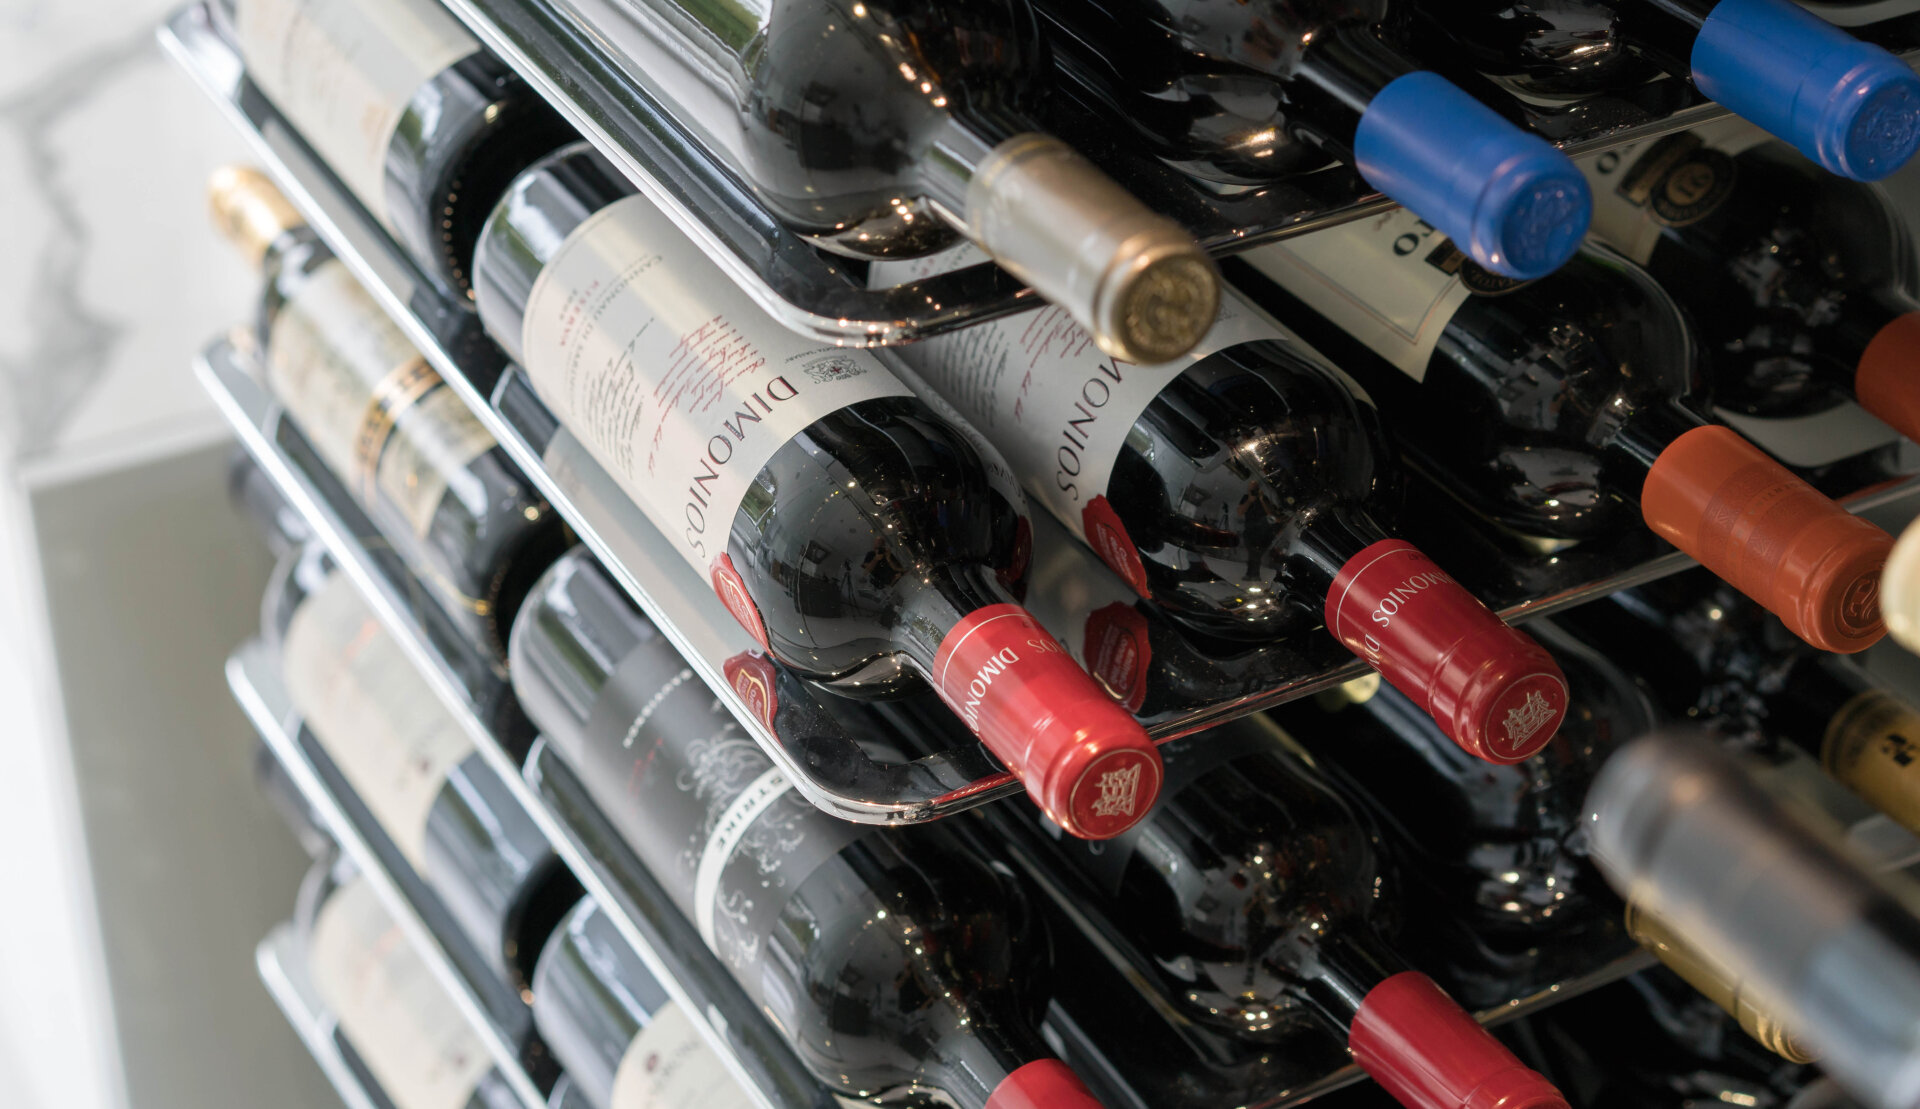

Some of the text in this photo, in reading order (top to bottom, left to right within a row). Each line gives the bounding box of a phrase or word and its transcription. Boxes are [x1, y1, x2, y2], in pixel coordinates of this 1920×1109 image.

[685, 376, 799, 558] DIMONIOS
[965, 646, 1020, 742] DIMONIO
[717, 776, 783, 851] STRIKE
